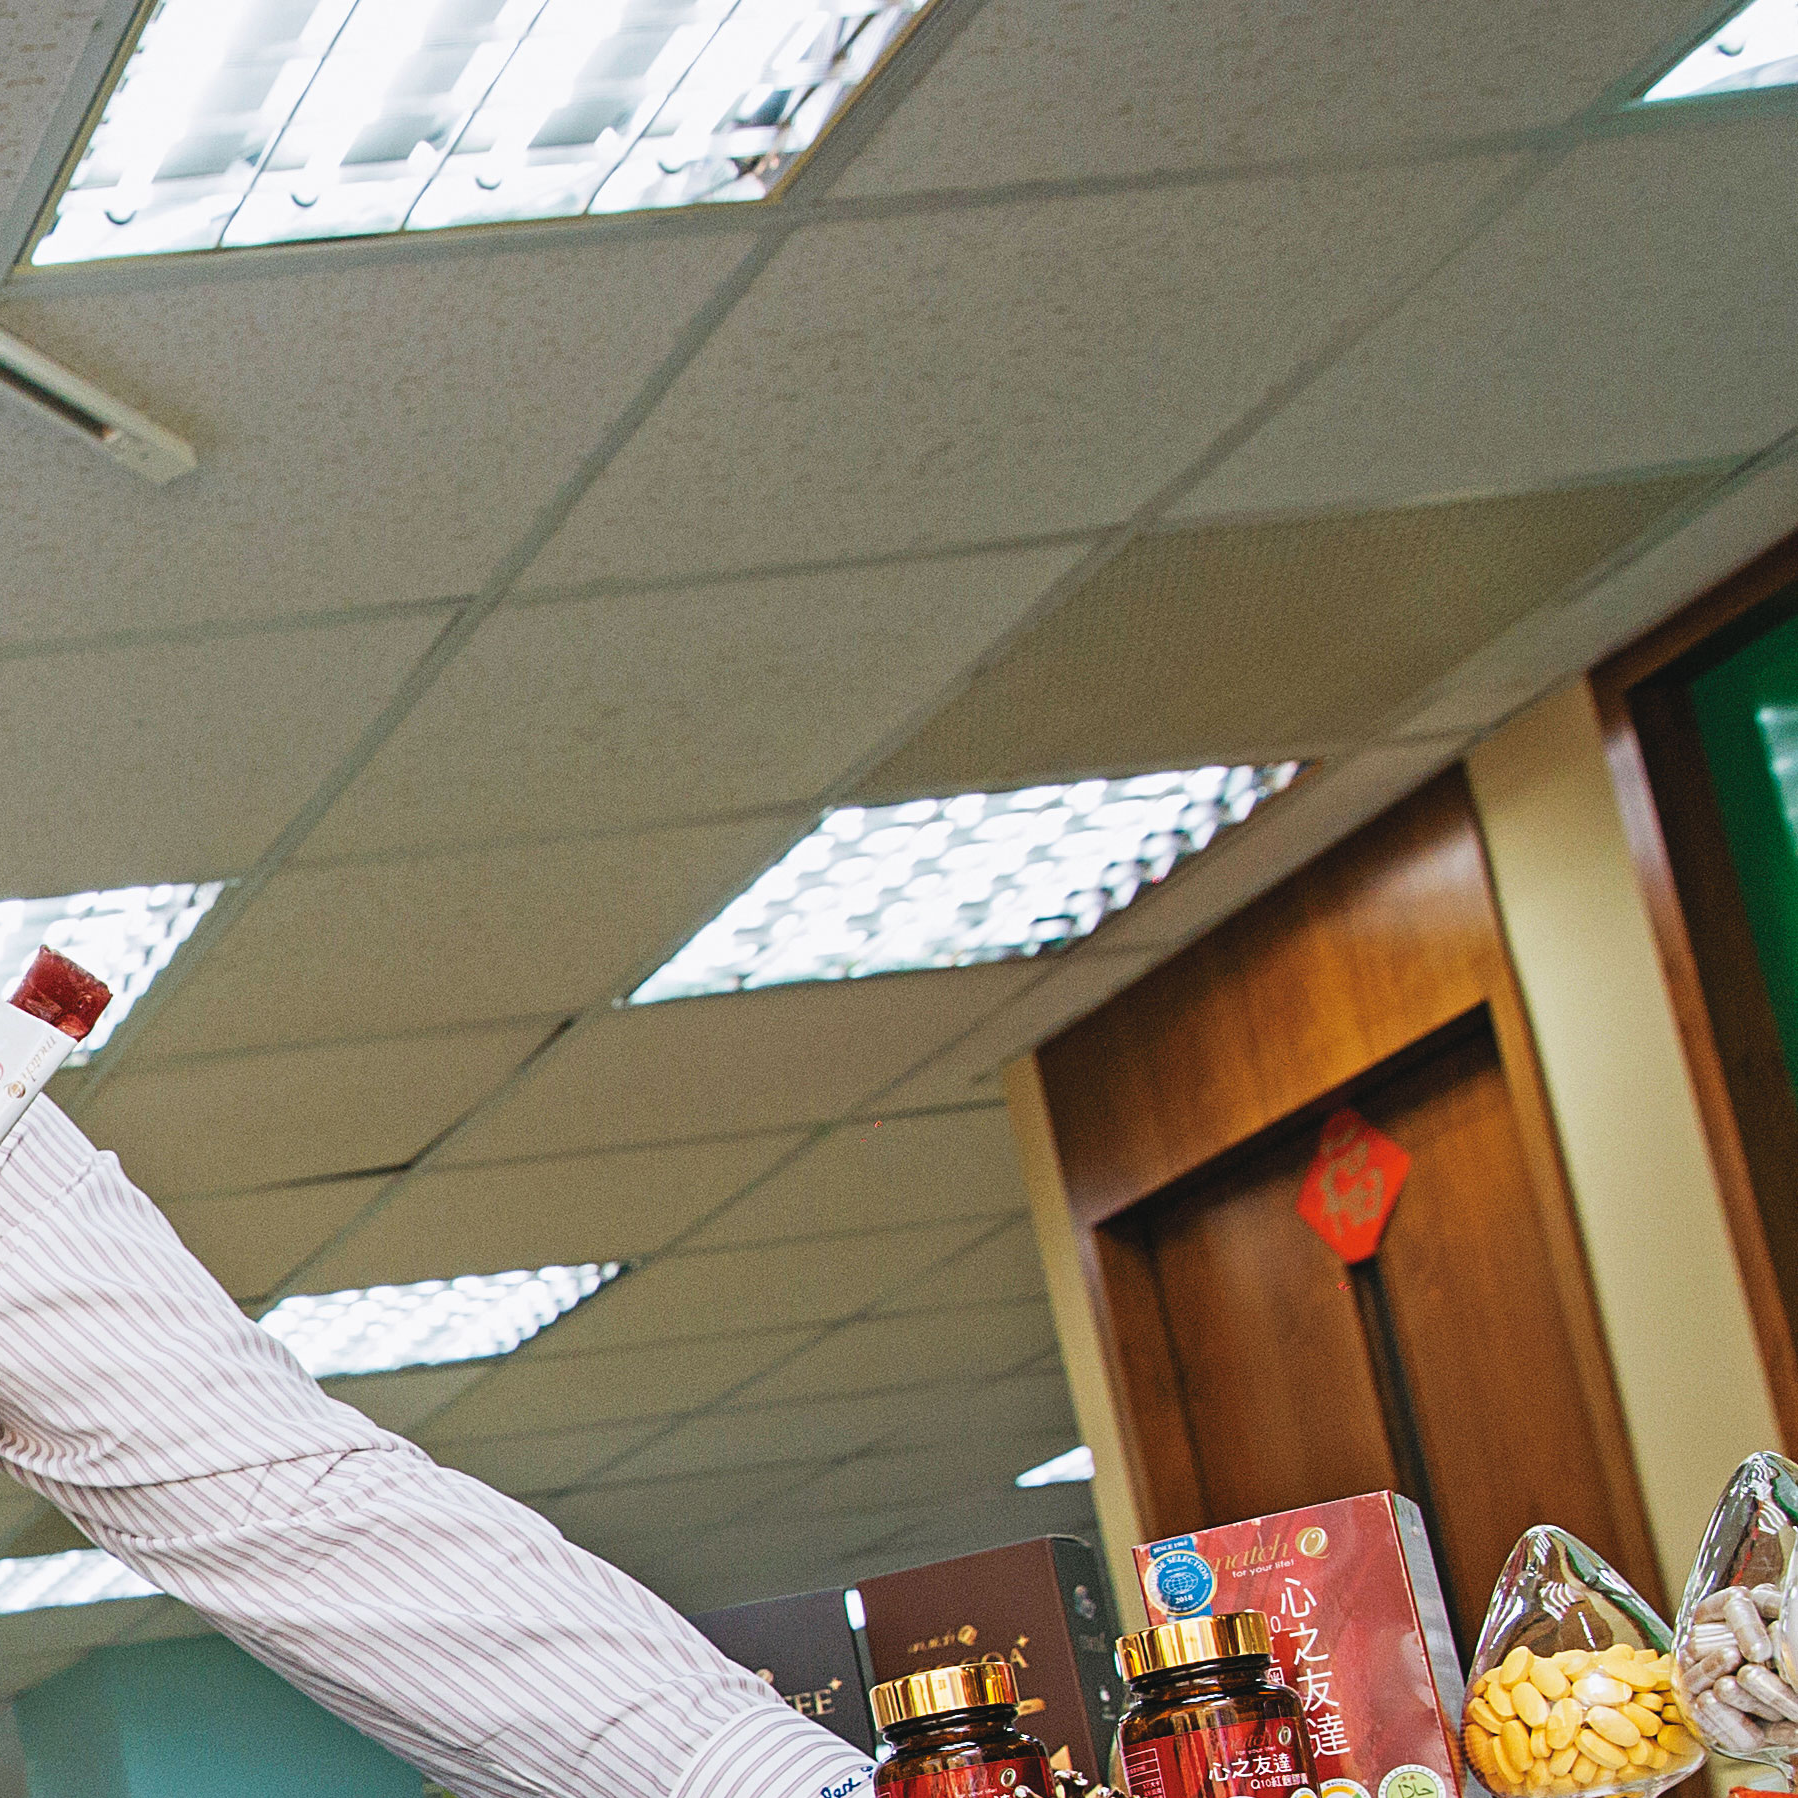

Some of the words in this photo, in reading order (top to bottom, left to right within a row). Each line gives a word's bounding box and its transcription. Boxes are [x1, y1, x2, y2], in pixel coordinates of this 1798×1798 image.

[1232, 1568, 1247, 1579] for
[1250, 1564, 1273, 1577] your
[1275, 1558, 1295, 1570] life!
[1280, 1577, 1351, 1759] 心之友達
[1208, 1752, 1293, 1782] 心之友達
